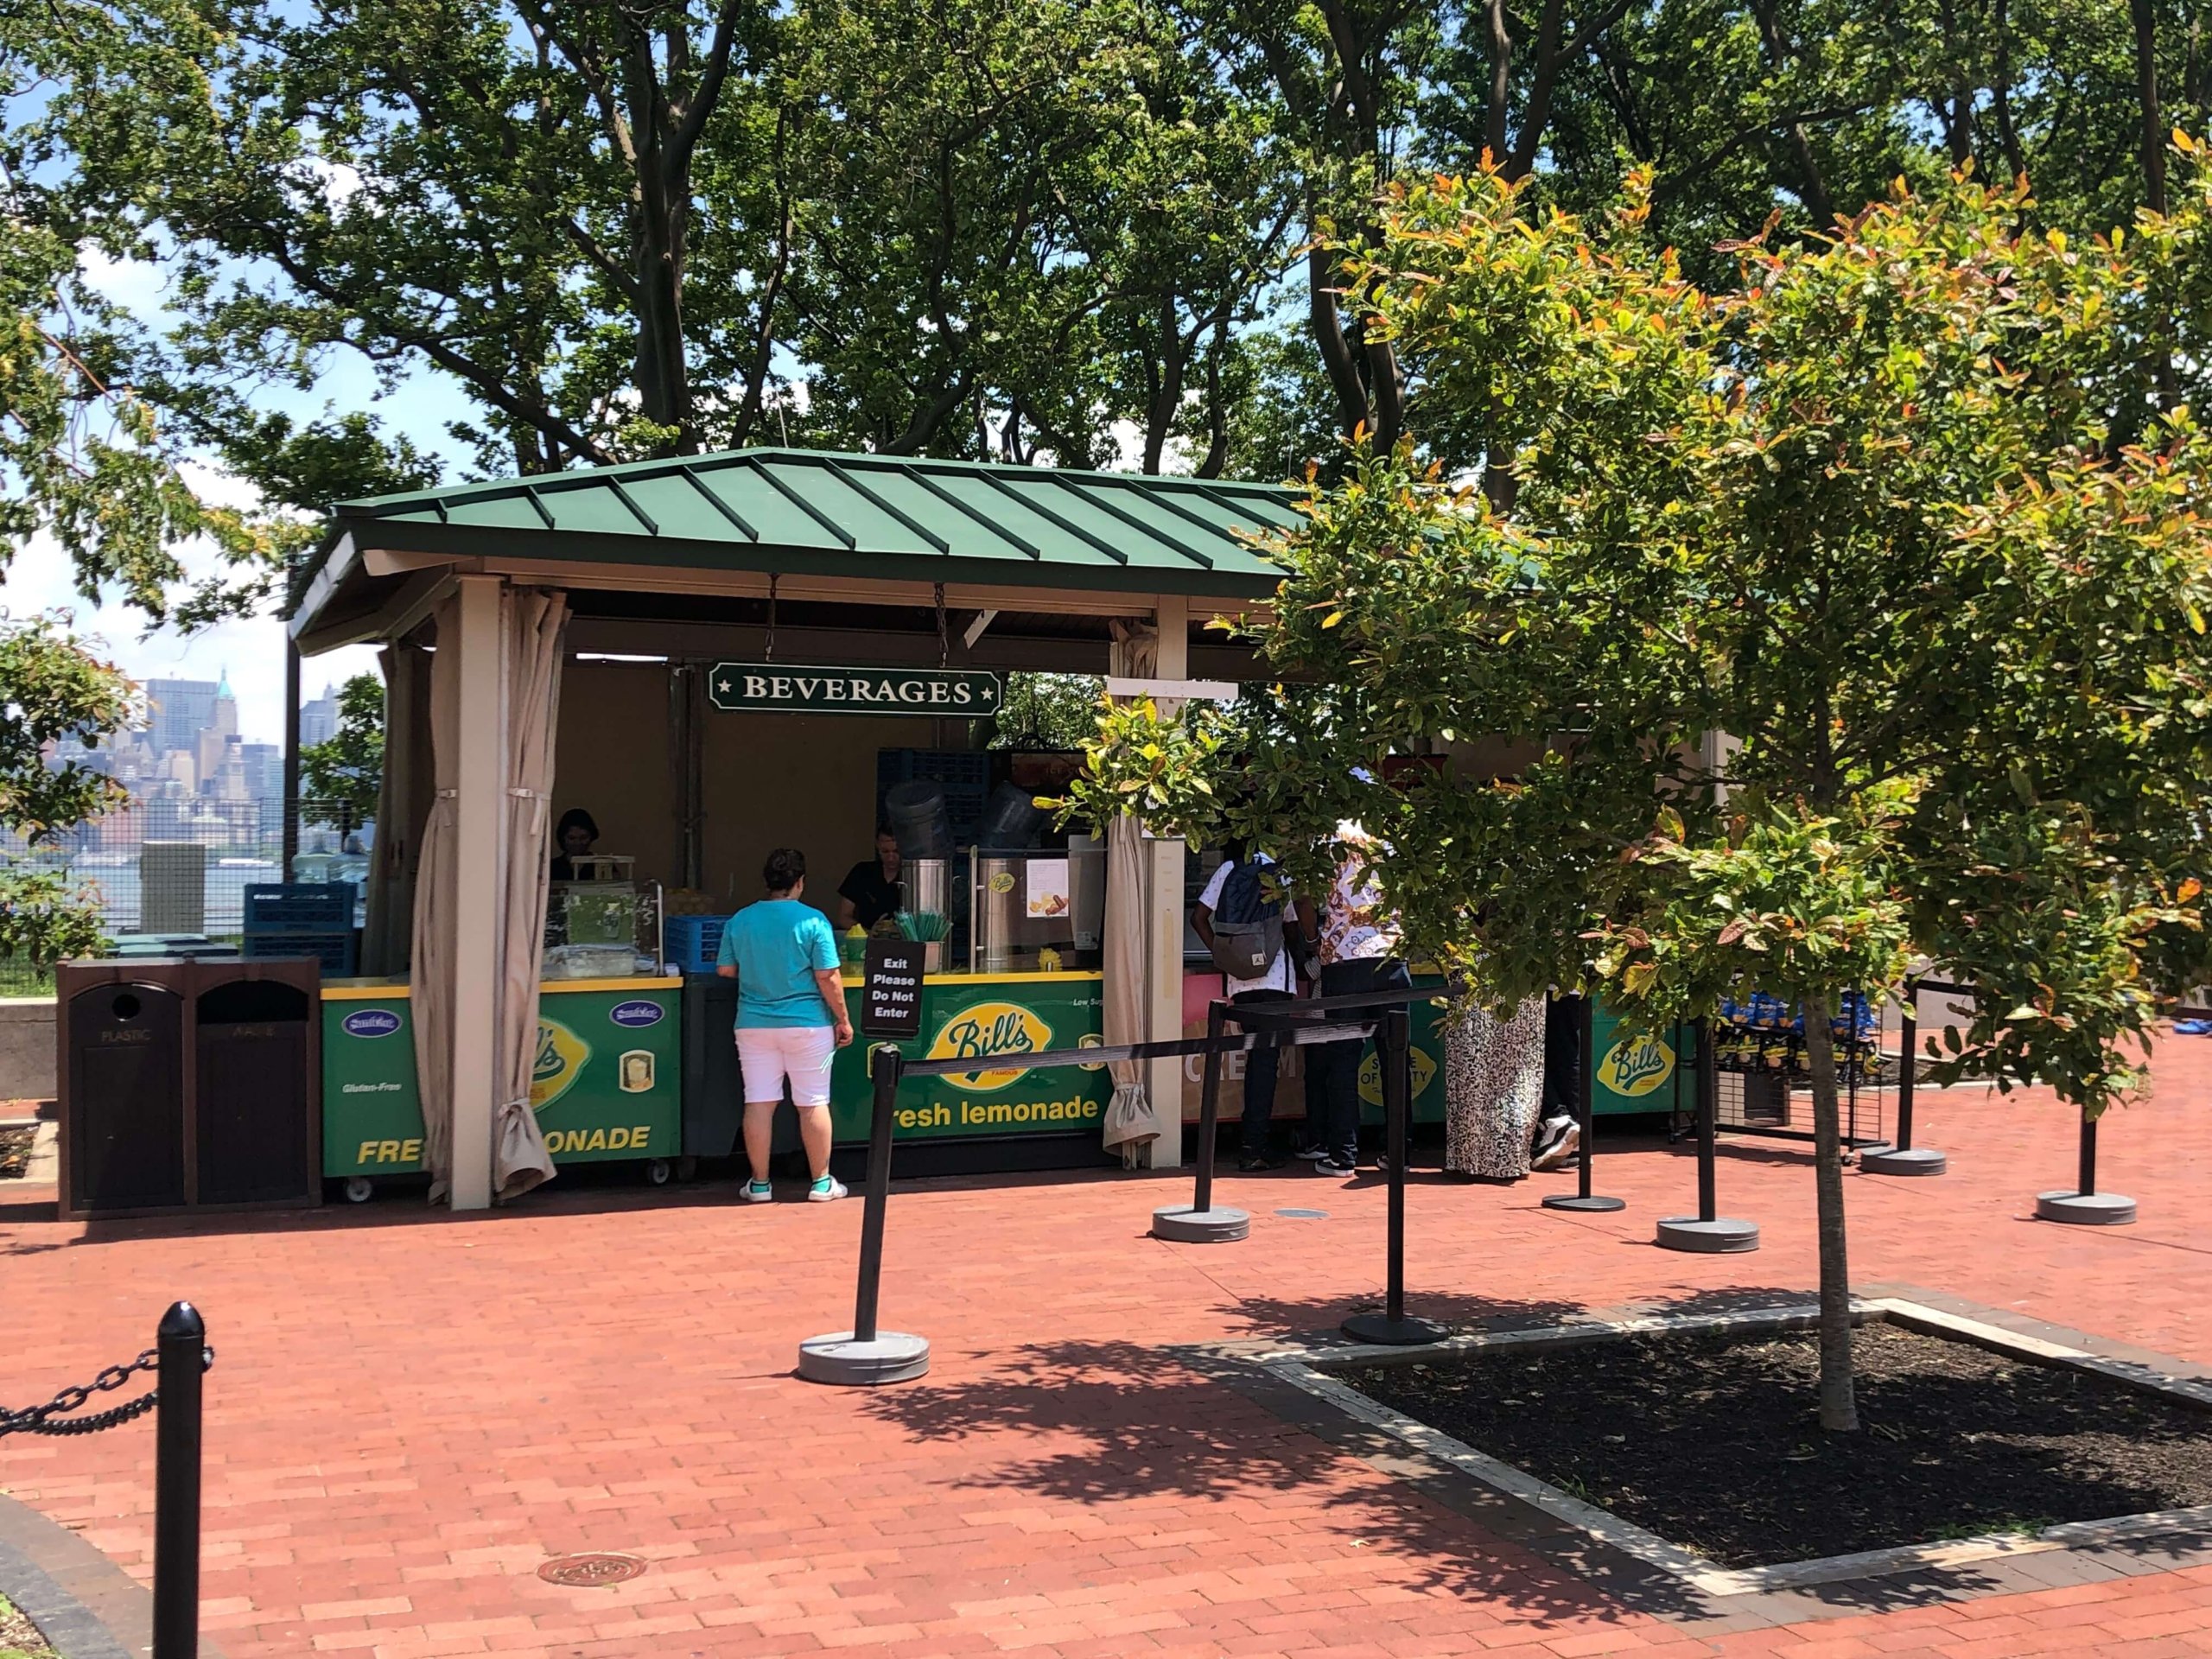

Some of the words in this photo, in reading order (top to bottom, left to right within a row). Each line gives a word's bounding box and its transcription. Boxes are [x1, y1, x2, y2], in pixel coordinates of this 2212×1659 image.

[742, 675, 971, 705] BEVERAGES
[883, 957, 908, 969] Exit
[873, 974, 916, 986] Please
[872, 990, 889, 1001] Do
[892, 991, 914, 1002] Not
[1072, 998, 1090, 1007] Low
[1090, 998, 1104, 1007] Sug
[874, 1007, 909, 1018] Enter
[101, 1028, 152, 1042] PLASTIC
[949, 1012, 1033, 1059] Bill's
[1185, 1046, 1296, 1083] CEM
[1611, 1041, 1666, 1086] Bill's
[342, 1082, 403, 1093] Gluten-Free
[893, 1102, 951, 1128] esh
[961, 1096, 1098, 1124] lemonade
[357, 1138, 423, 1165] FRE
[545, 1125, 652, 1154] ONADE
